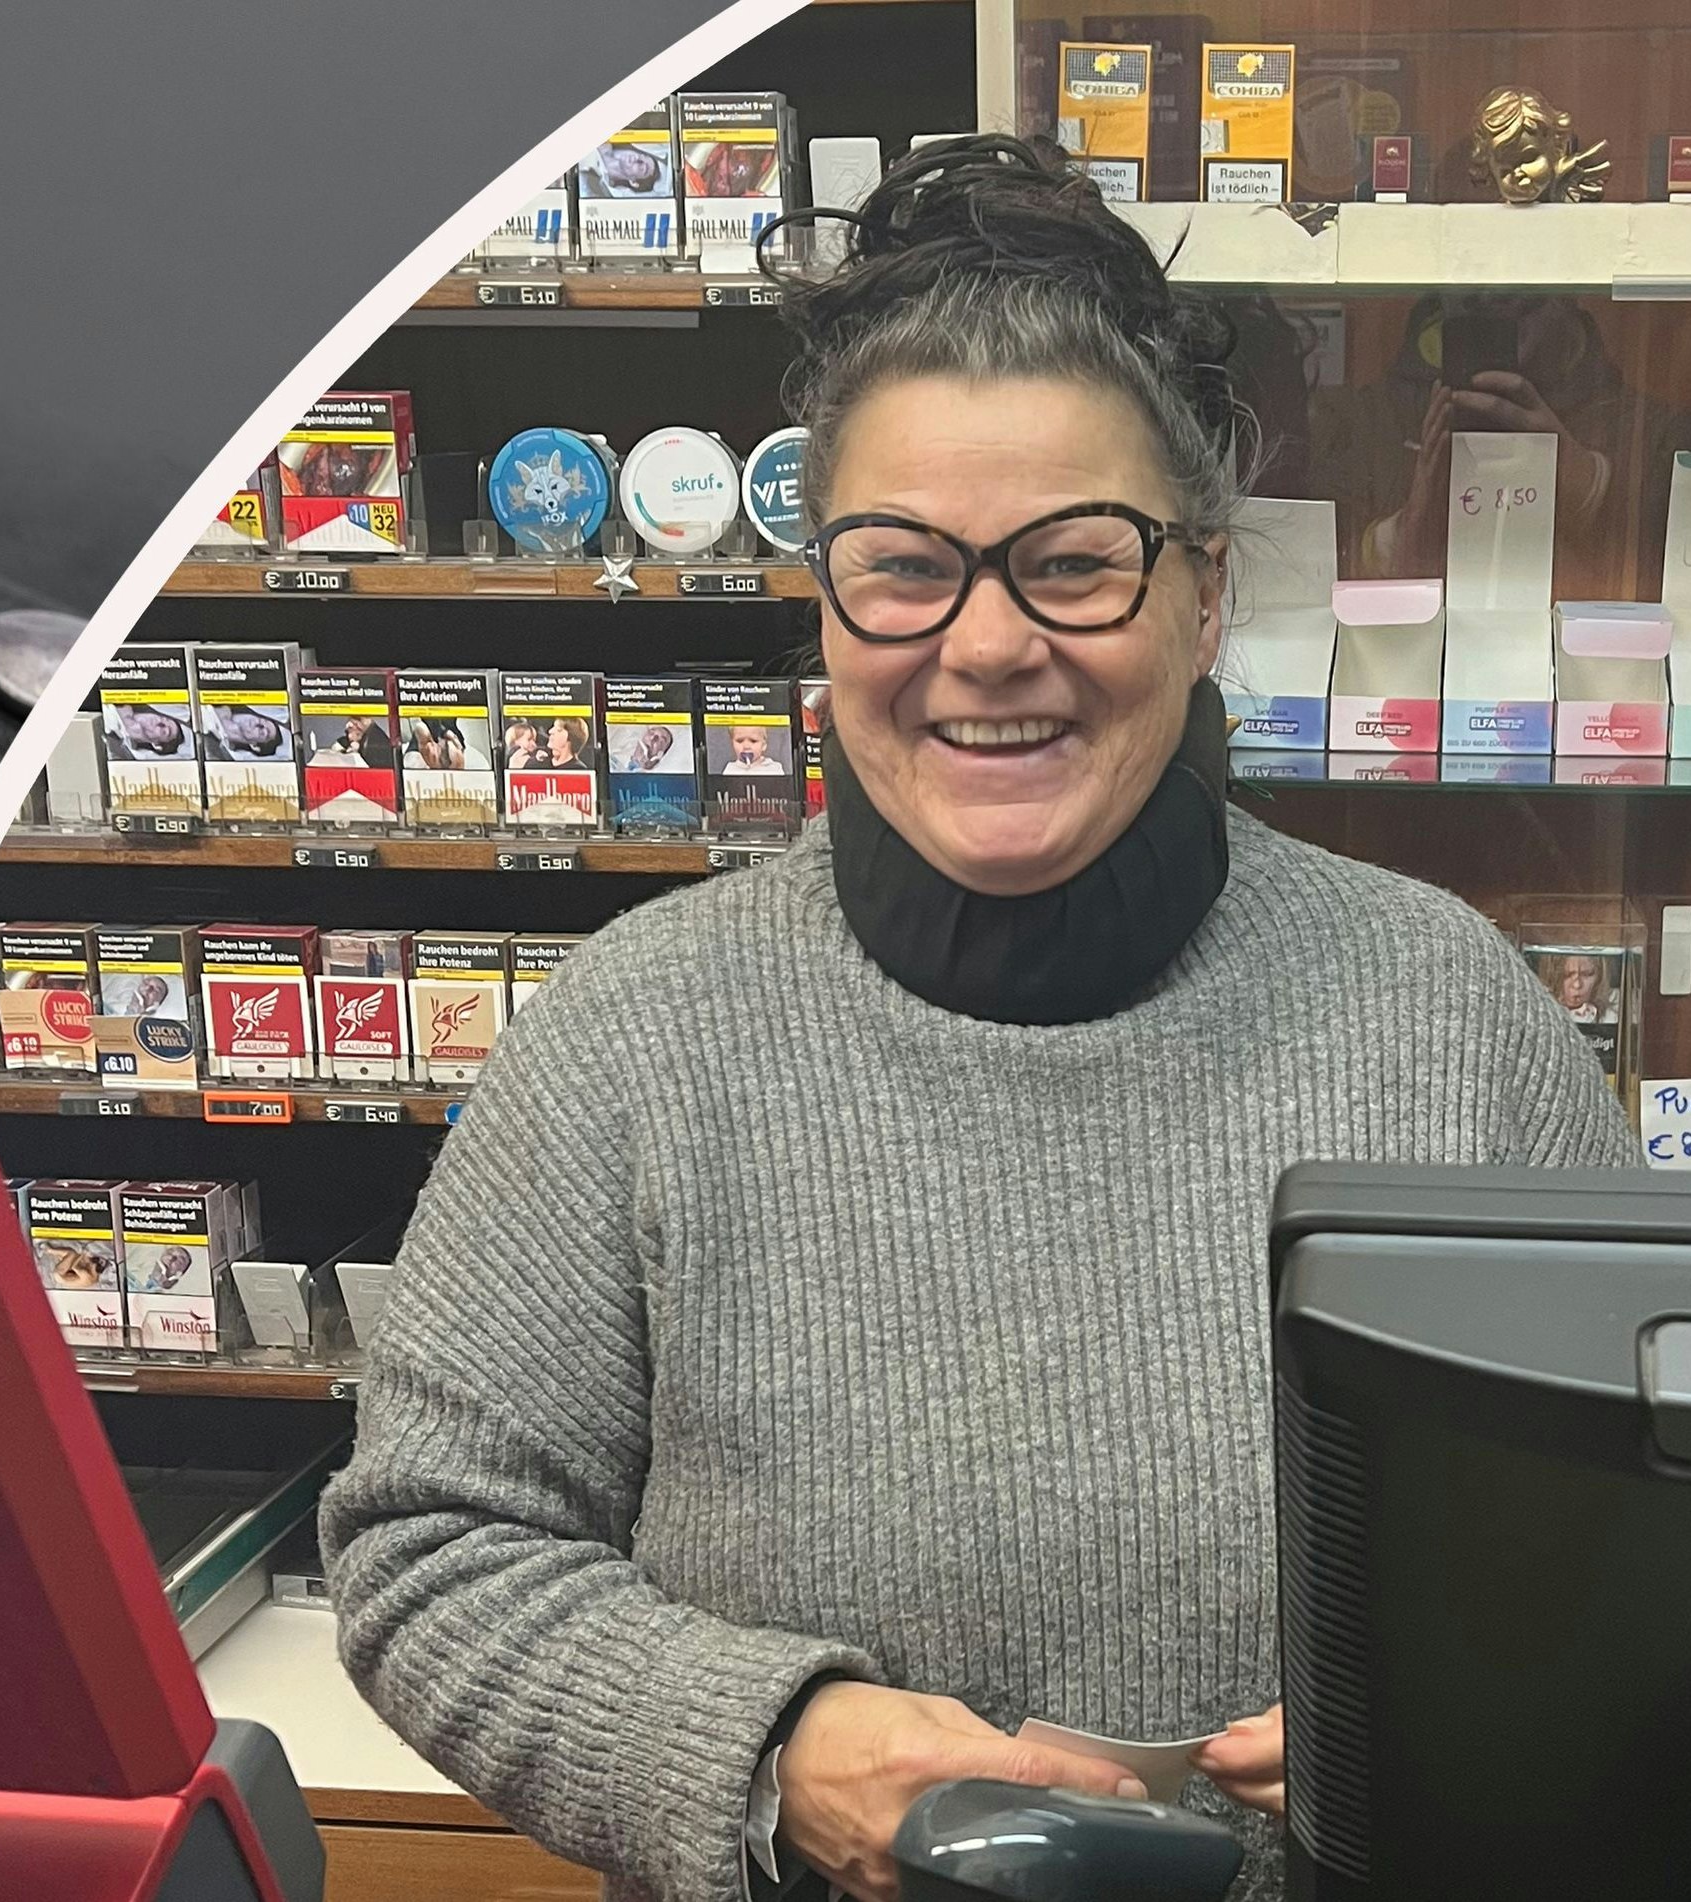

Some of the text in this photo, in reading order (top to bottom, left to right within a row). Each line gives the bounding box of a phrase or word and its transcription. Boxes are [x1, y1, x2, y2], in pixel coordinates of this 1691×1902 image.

[1072, 83, 1137, 97] COHIBA
[1216, 85, 1282, 97] COHIBA
[1220, 167, 1271, 178] Rauchen
[1211, 181, 1270, 194] ist tödlich
[1494, 487, 1538, 512] 8,50
[231, 500, 257, 520] 22
[373, 505, 394, 514] NEU
[374, 515, 395, 531] 32
[296, 571, 339, 589] 10.00
[722, 575, 757, 592] 6.00
[398, 678, 482, 692] Rauchen verstopft
[400, 691, 458, 702] Ihre Arterien
[1245, 721, 1271, 731] ELFA
[1357, 724, 1383, 735] ELFA
[1471, 719, 1497, 729] ELFA
[1584, 727, 1611, 738] ELFA
[406, 772, 496, 810] Marlboro
[512, 778, 591, 812] Marlboro
[155, 816, 188, 833] 6.90
[335, 851, 369, 867] 6.90
[539, 855, 572, 870] 6.90
[418, 943, 499, 957] Rauchen bedroht
[516, 946, 557, 957] Rauchen
[418, 956, 472, 968] Ihre Potenz
[517, 958, 559, 969] Ihre Pote
[52, 1001, 87, 1014] LUCKY
[53, 1014, 90, 1027] STRIKE
[146, 1024, 182, 1037] LUCKY
[370, 1031, 392, 1040] SOFT
[148, 1035, 188, 1048] STRIKE
[236, 1042, 283, 1051] GAULOISES
[339, 1042, 387, 1052] GAULOISES
[98, 1100, 131, 1115] 6.10
[249, 1101, 282, 1116] 7.00
[365, 1107, 398, 1123] 6.40
[30, 1197, 109, 1211] Rauchen bedroht
[51, 1212, 83, 1222] Potenz
[68, 1311, 118, 1330] Winston
[160, 1316, 211, 1335] Winston
